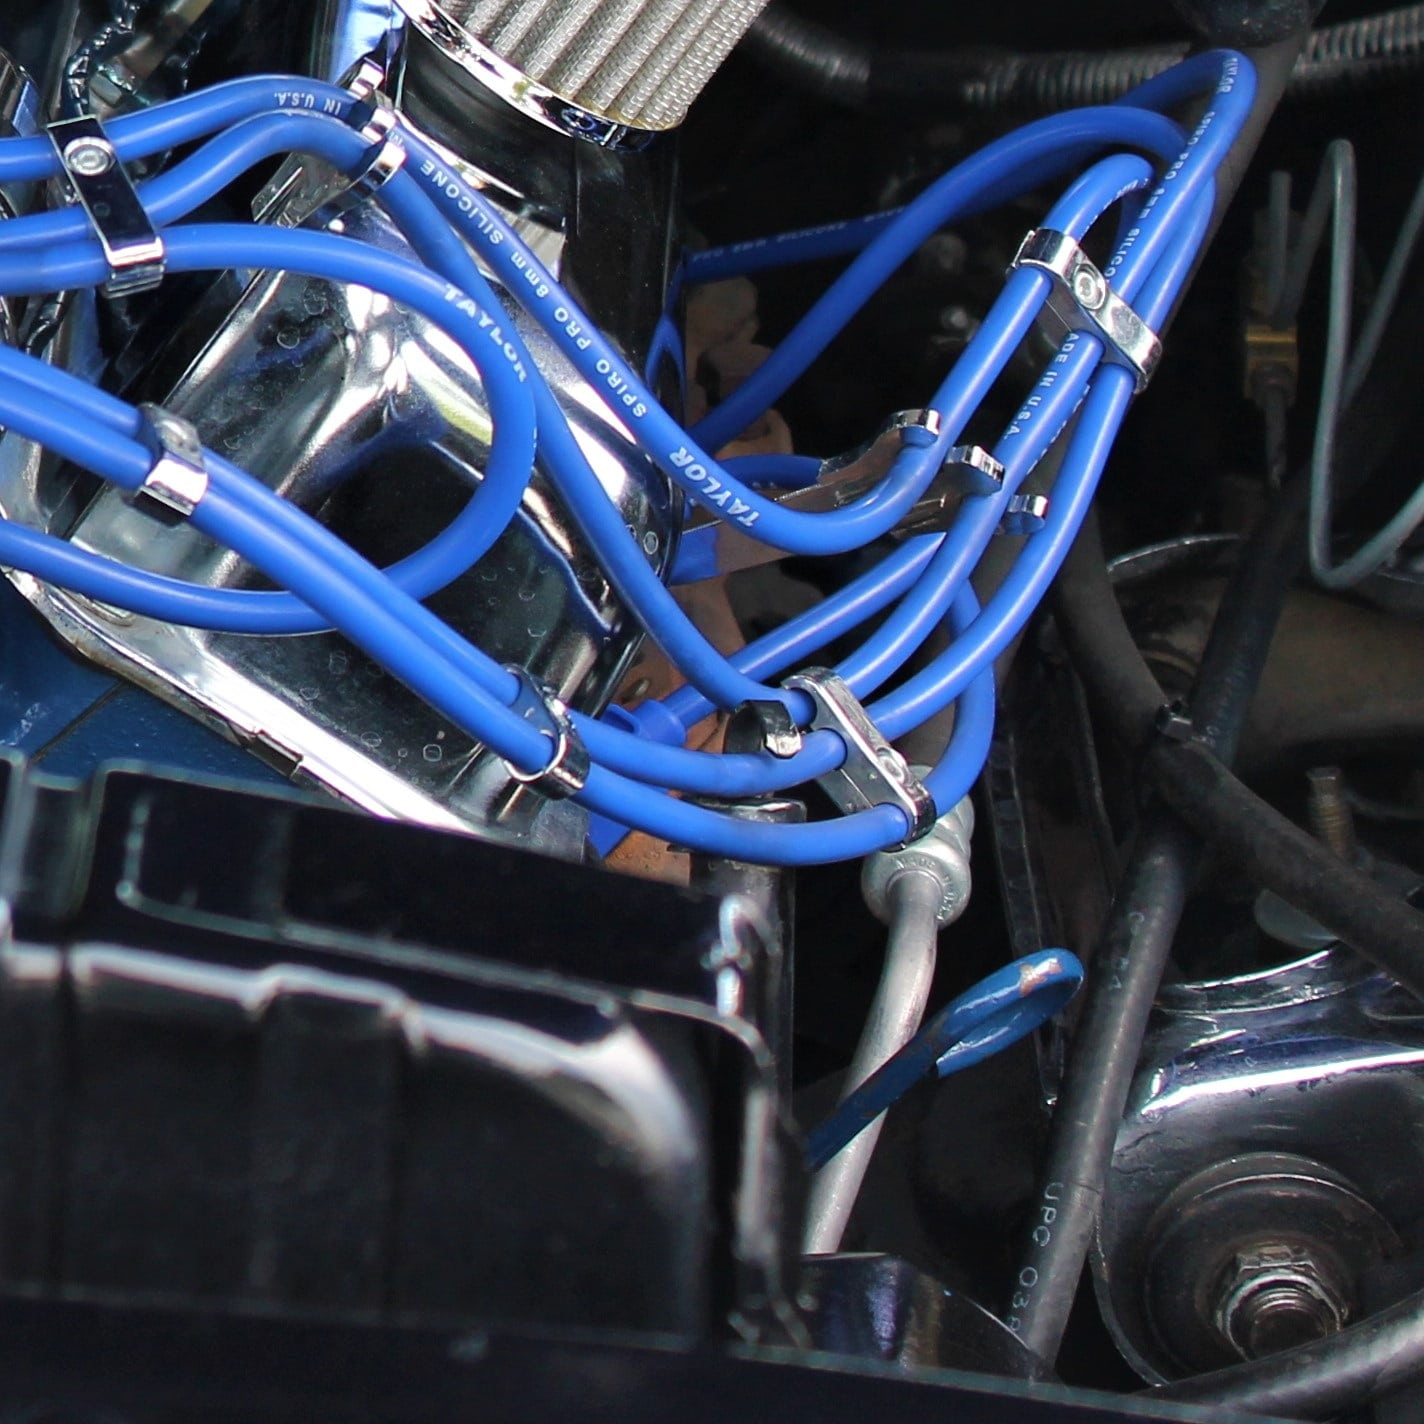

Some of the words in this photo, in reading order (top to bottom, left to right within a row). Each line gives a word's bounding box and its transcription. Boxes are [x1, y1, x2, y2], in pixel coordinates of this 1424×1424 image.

[273, 91, 315, 108] U.S.A.
[323, 97, 342, 116] IN
[419, 159, 505, 246] SILICONE
[510, 251, 550, 299] 8mm
[1103, 227, 1141, 278] SILICO
[554, 306, 591, 351] PRO
[1055, 332, 1080, 364] ADE
[595, 359, 648, 418] SPIRO
[1039, 371, 1058, 388] IN
[1003, 395, 1042, 441] U.S.A.
[668, 446, 760, 527] TAYLOR
